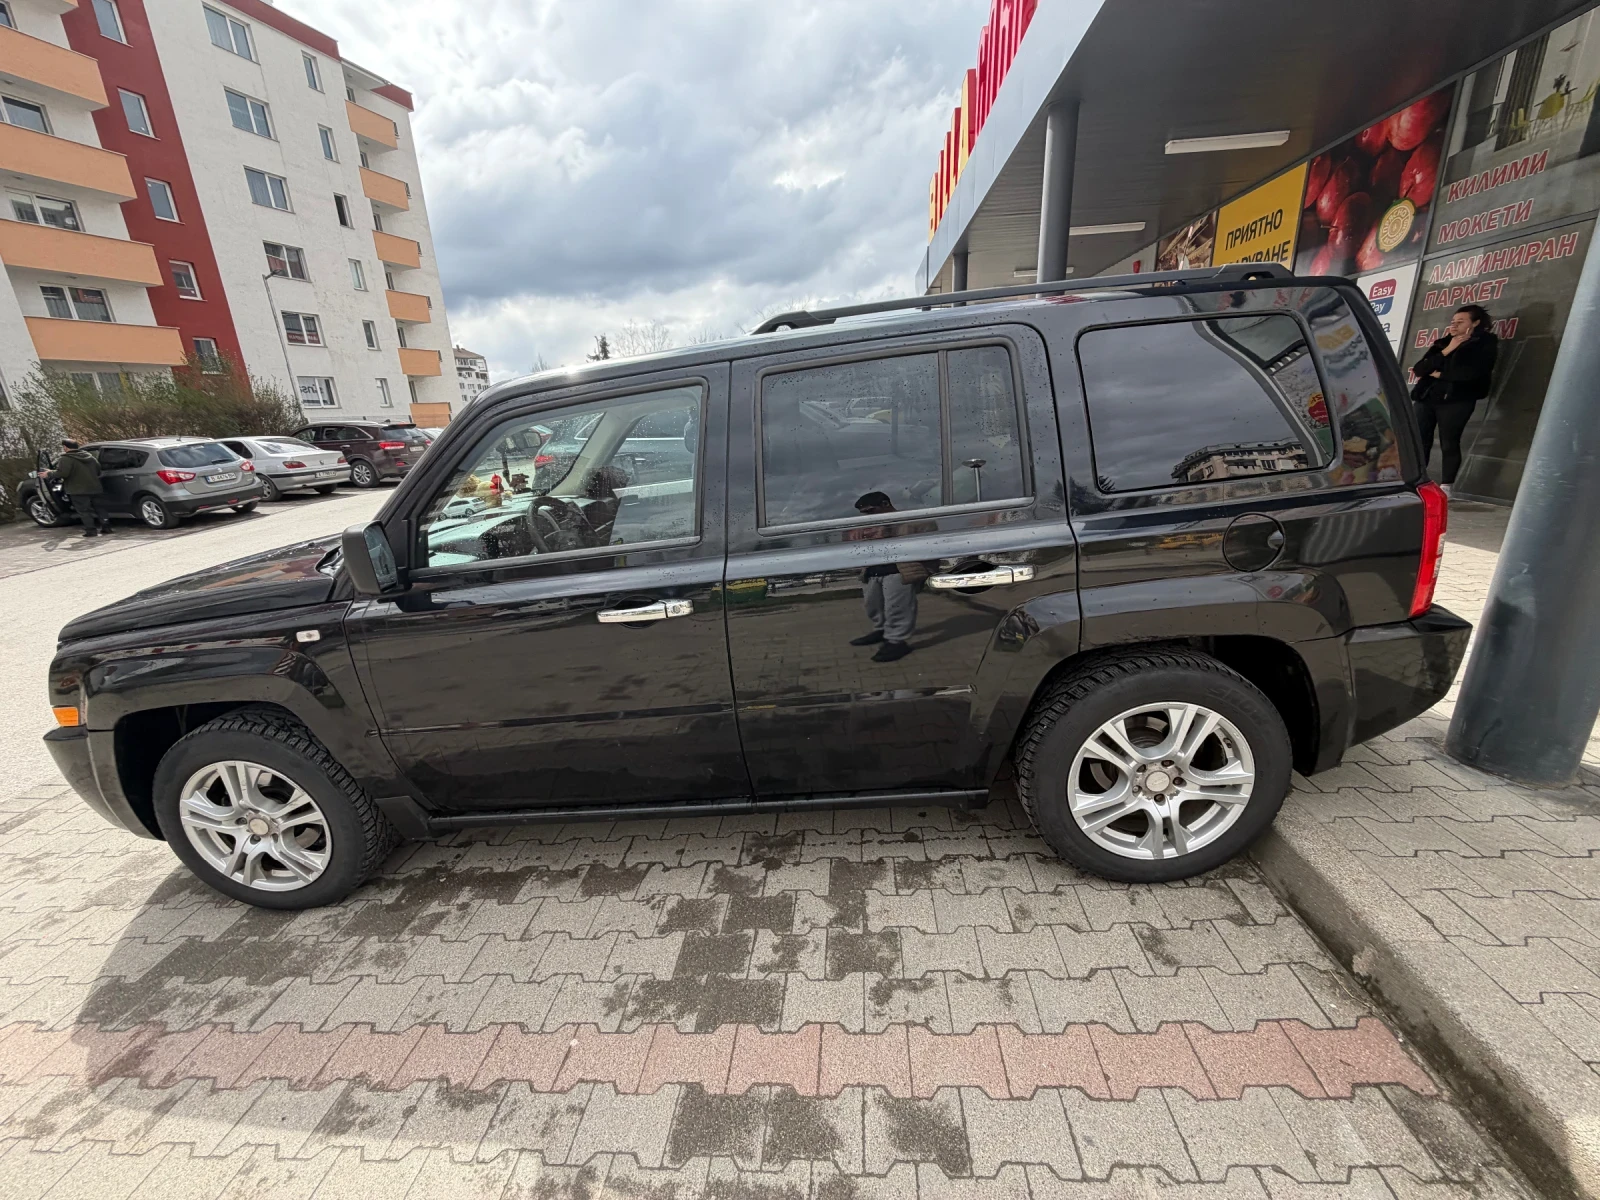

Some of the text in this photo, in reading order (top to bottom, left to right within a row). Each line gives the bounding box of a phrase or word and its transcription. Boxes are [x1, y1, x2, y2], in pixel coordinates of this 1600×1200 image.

[1447, 149, 1549, 204] КИЛИМИ
[1225, 209, 1283, 251] ПРИЯТНО
[1437, 198, 1534, 244] МОКЕТИ
[1428, 232, 1579, 285] ЛАМИНИРАН
[1371, 285, 1393, 298] Easy
[1423, 277, 1509, 311] ПАРКЕТ
